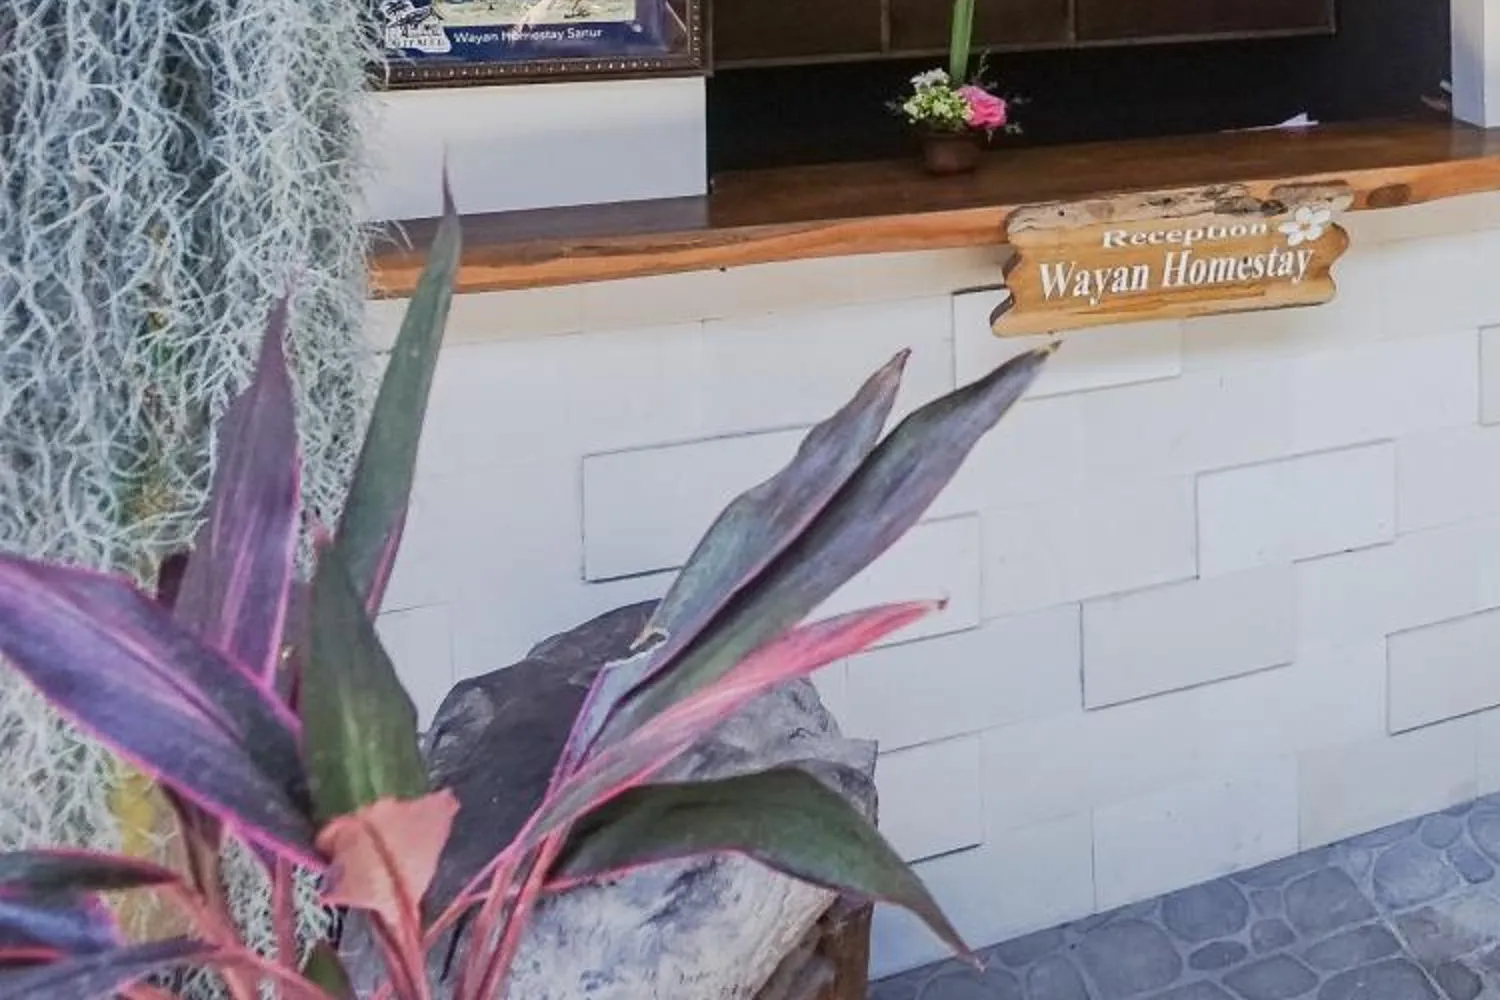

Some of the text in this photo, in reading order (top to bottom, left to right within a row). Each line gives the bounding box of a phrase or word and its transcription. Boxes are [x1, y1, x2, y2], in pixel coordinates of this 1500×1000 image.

[453, 30, 499, 45] Wayan
[501, 29, 564, 42] Homestay
[567, 26, 604, 40] Sanur
[1102, 221, 1268, 249] Reception
[1039, 247, 1314, 305] Wayan Homestay
